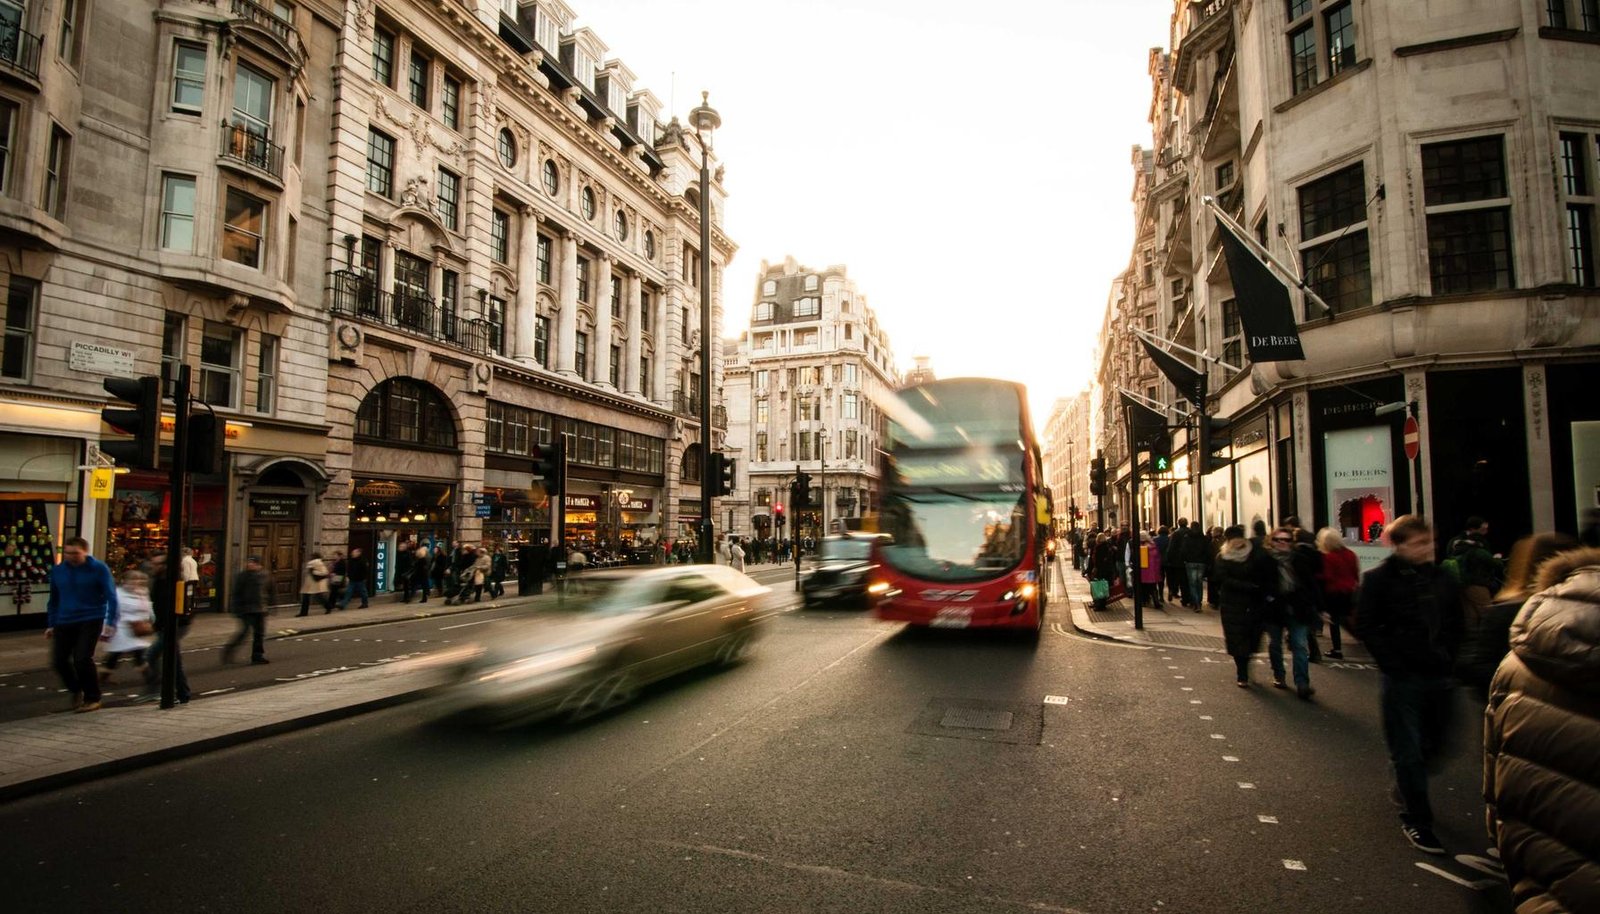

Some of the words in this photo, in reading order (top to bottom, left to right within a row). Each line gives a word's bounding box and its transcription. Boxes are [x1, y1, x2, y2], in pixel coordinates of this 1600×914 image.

[1252, 336, 1269, 348] DE
[1270, 335, 1298, 346] BEERS
[75, 342, 120, 355] PICCADILLY
[1352, 469, 1388, 477] BEERS
[94, 476, 108, 488] itsu
[377, 542, 385, 589] MONEY
